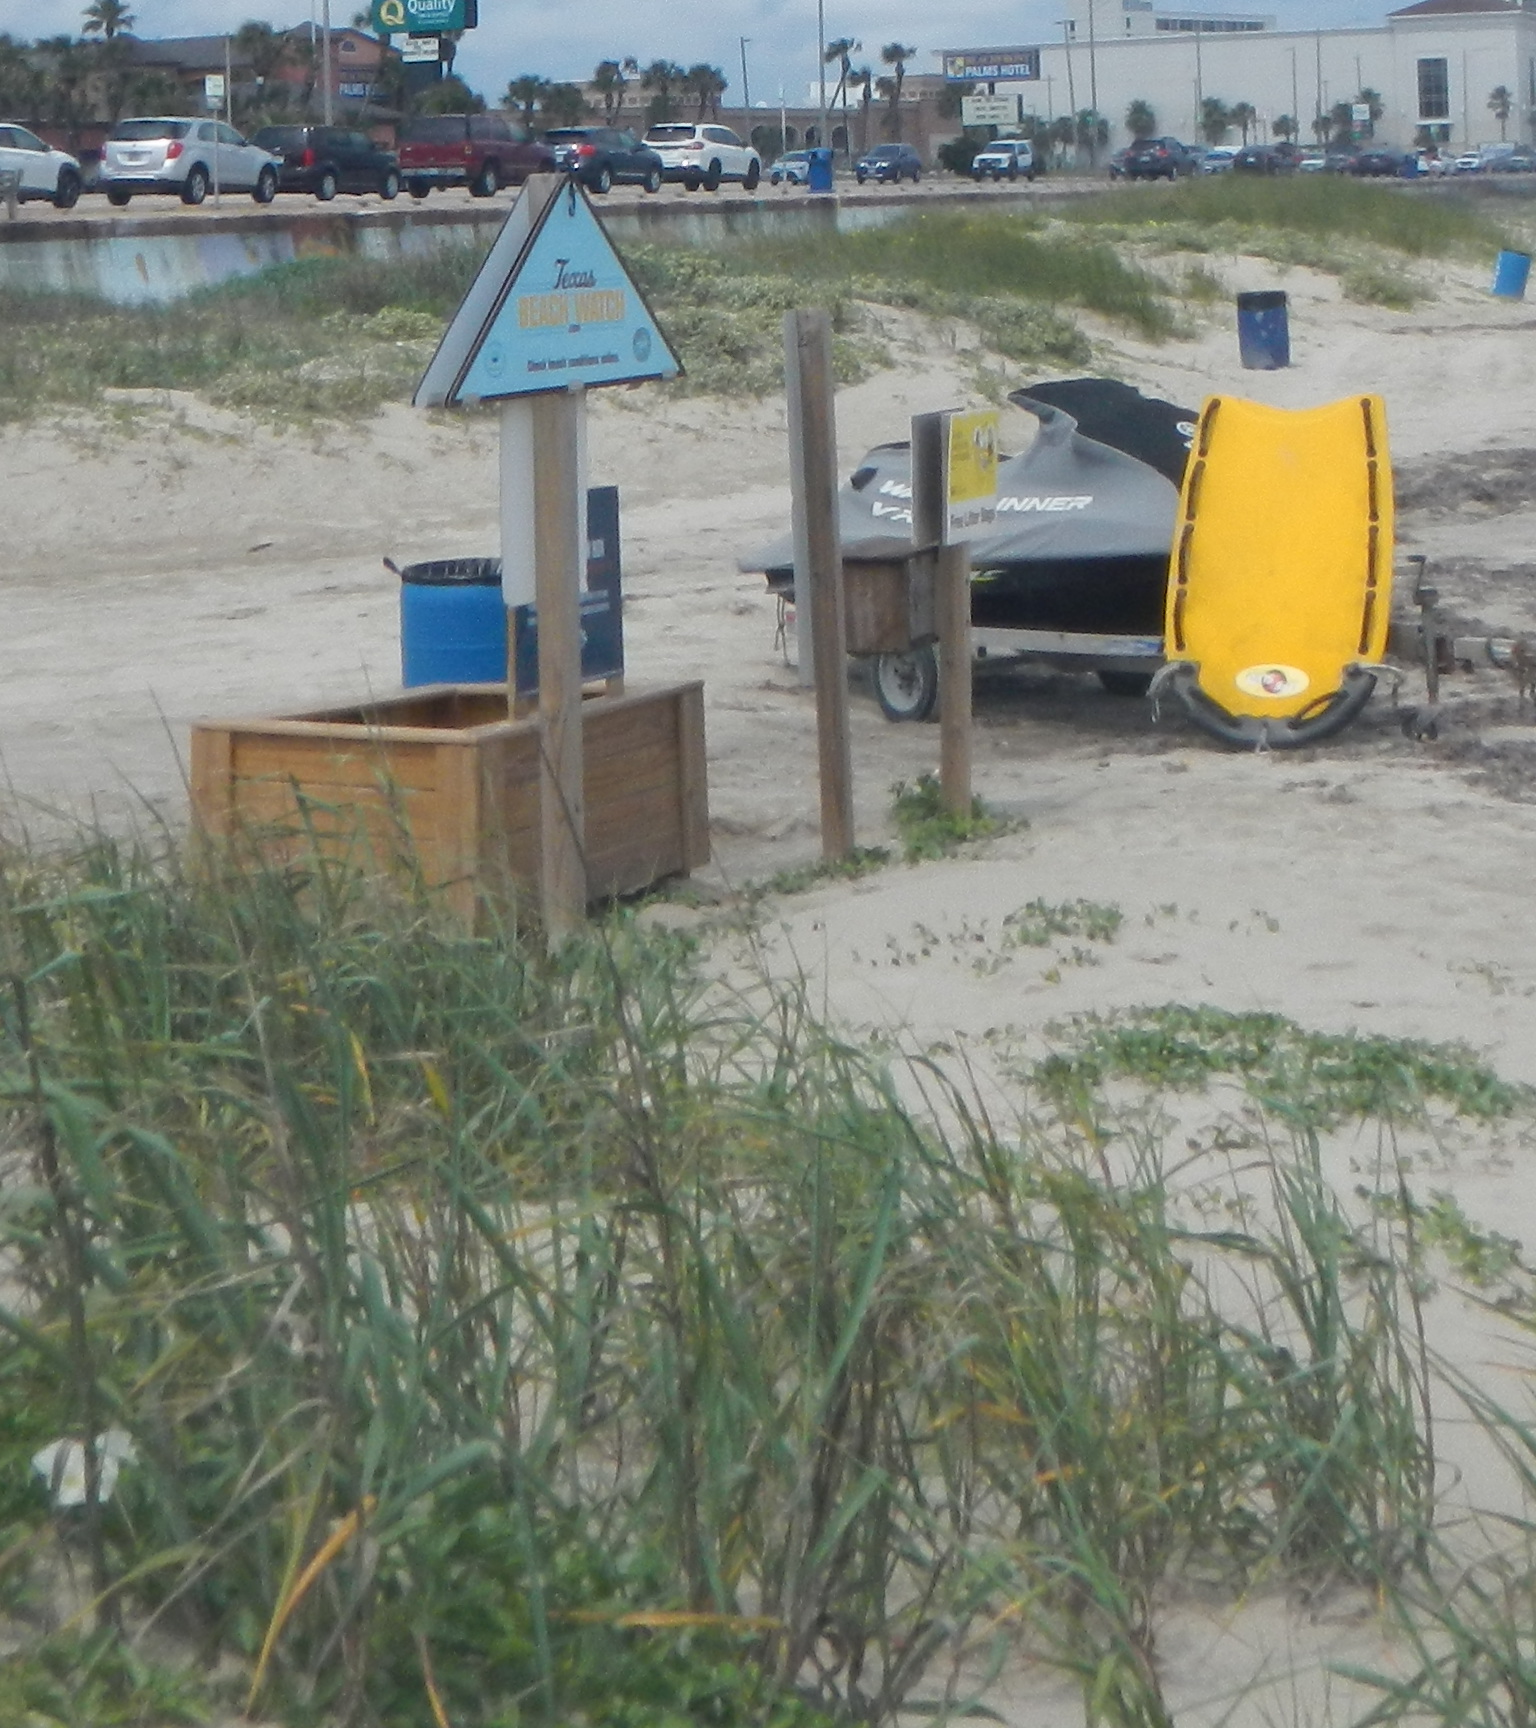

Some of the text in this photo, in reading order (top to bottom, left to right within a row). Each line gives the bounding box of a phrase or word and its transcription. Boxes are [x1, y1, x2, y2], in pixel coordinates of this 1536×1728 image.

[965, 64, 1031, 78] PALMS HOTEL
[554, 258, 598, 290] Texas
[518, 289, 626, 329] BEACH WATCH
